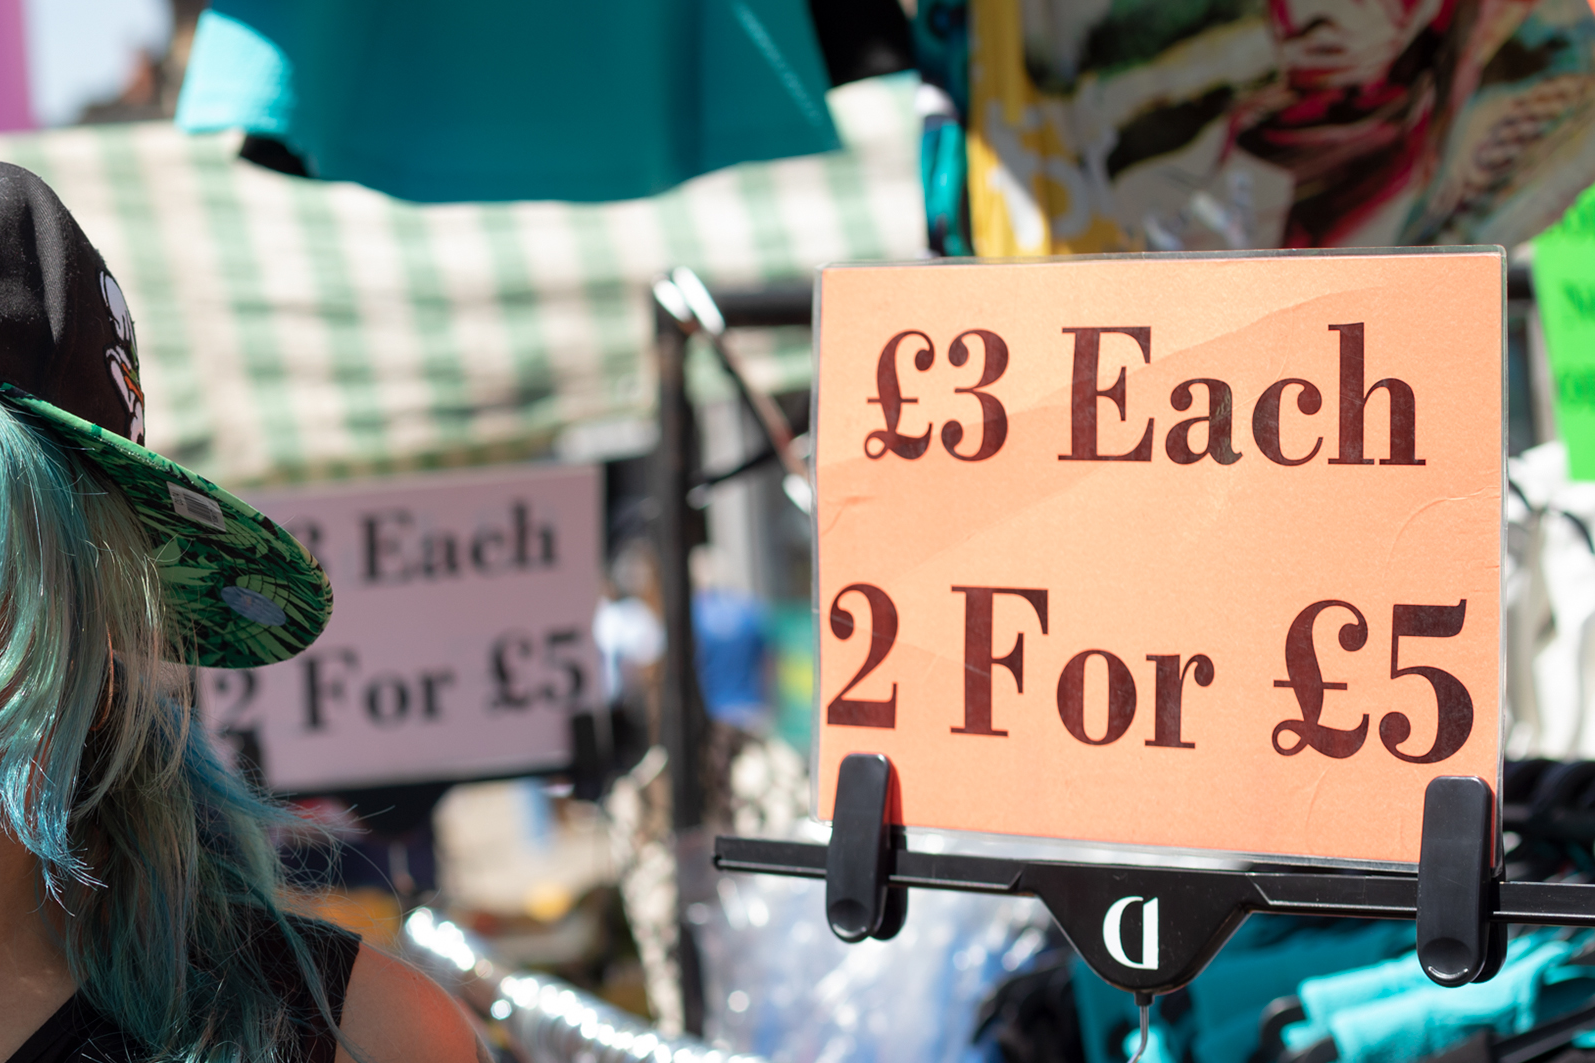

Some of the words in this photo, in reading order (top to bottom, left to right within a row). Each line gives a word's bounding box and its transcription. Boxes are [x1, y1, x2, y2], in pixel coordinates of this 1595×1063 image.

[862, 329, 1010, 463] £3
[1057, 321, 1427, 467] Each
[359, 502, 559, 586] Each
[299, 648, 454, 736] For
[487, 628, 586, 713] £5
[826, 583, 900, 730] 2
[950, 585, 1216, 750] For
[1270, 598, 1476, 766] £5
